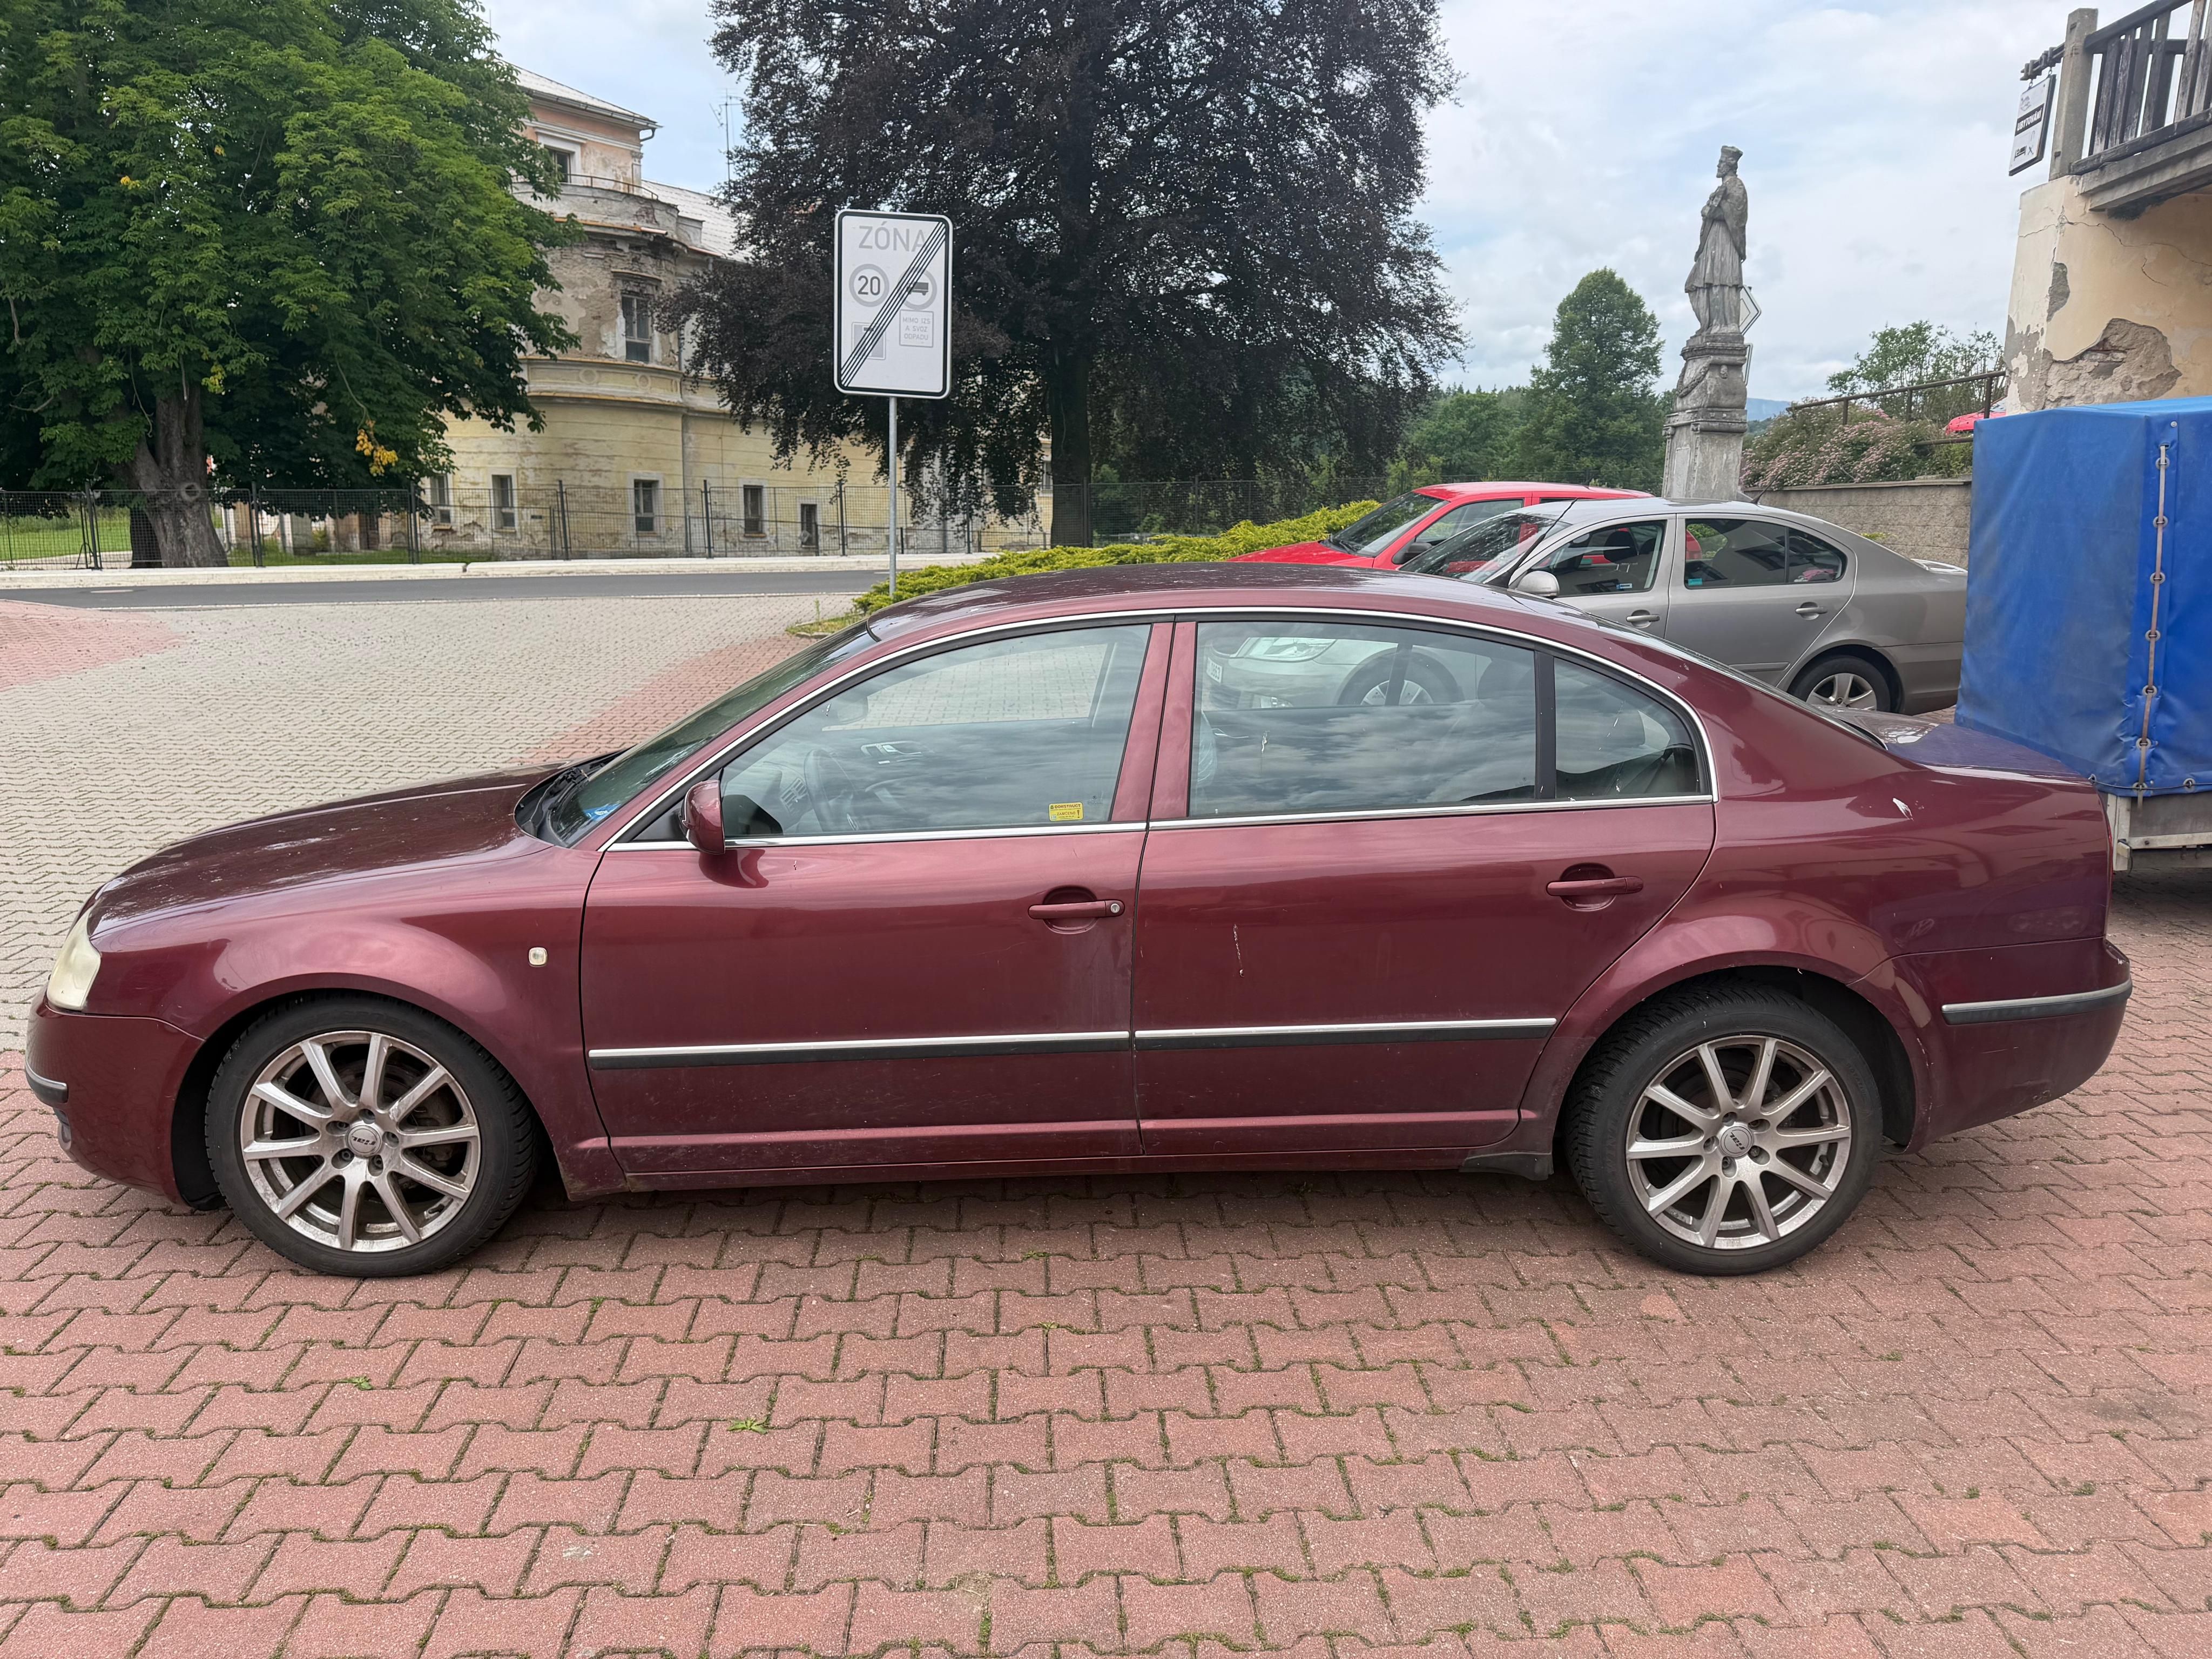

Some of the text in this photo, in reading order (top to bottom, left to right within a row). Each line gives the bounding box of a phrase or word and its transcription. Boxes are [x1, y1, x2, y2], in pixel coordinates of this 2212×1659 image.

[2017, 107, 2042, 131] UBYTOVÁNÍ
[858, 220, 926, 252] ZÓNA
[857, 275, 881, 296] 20
